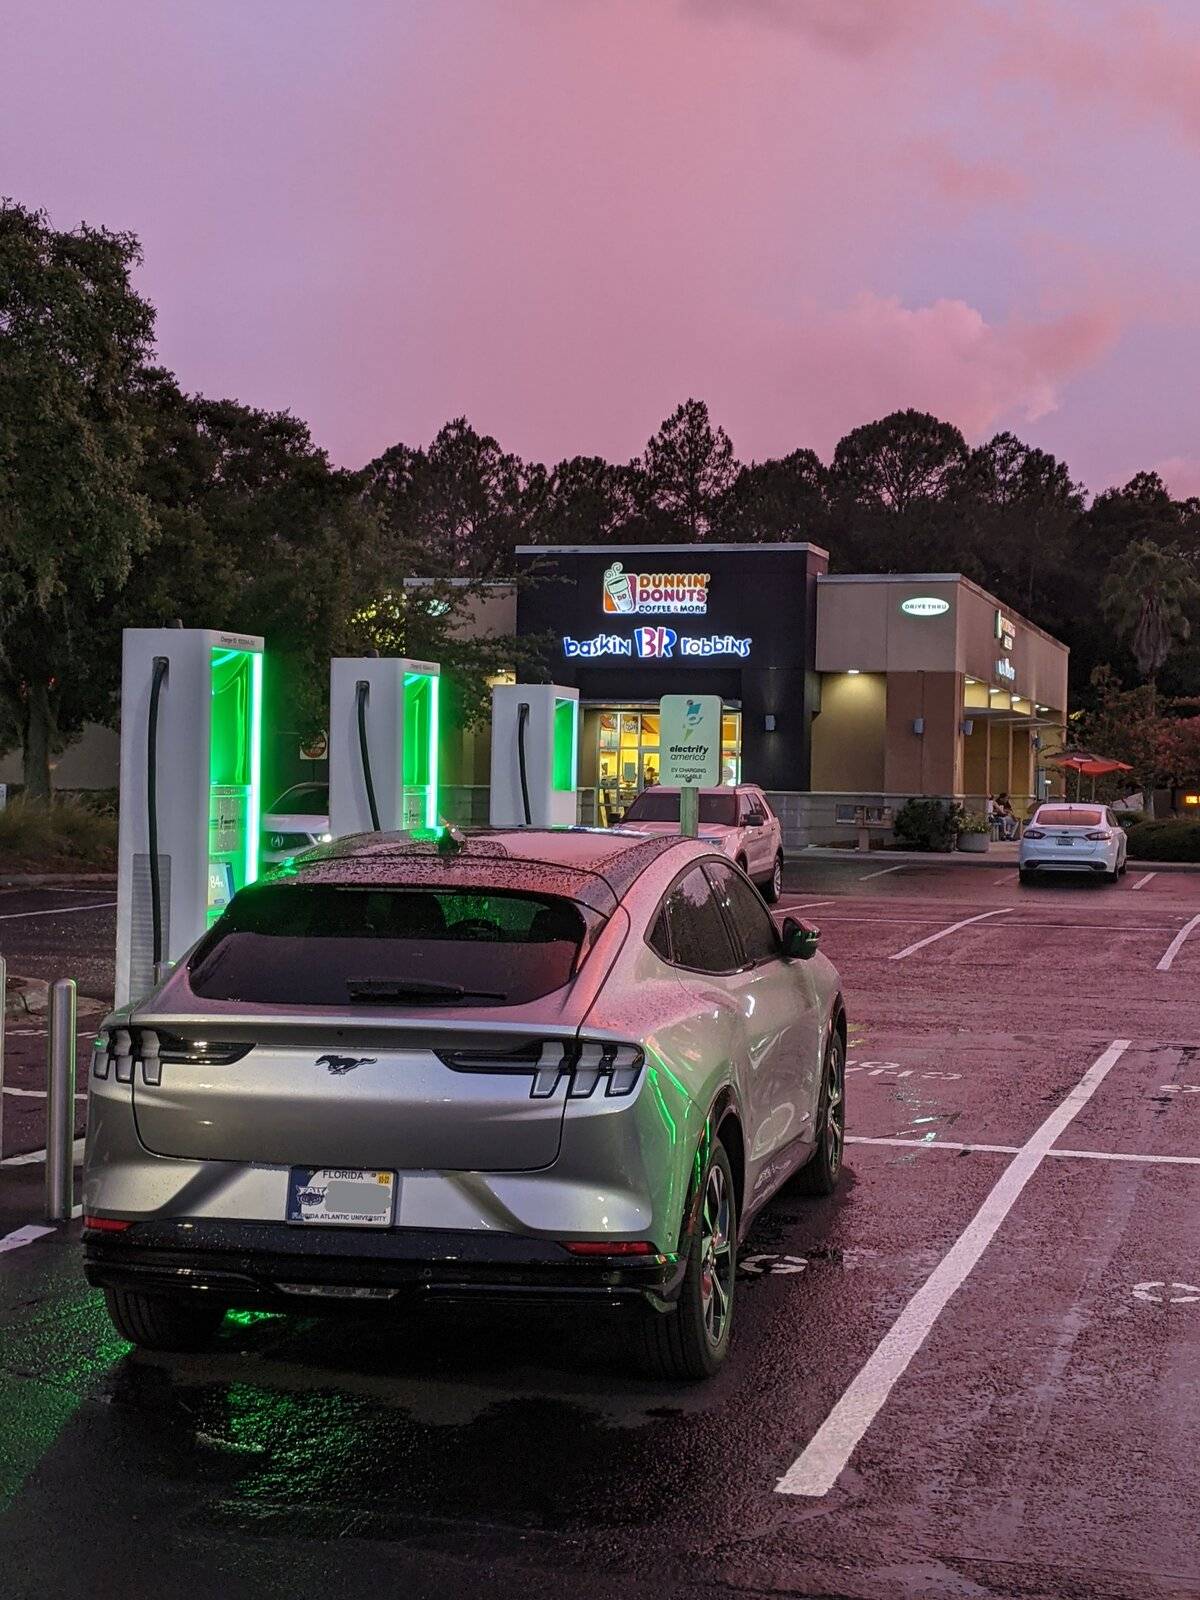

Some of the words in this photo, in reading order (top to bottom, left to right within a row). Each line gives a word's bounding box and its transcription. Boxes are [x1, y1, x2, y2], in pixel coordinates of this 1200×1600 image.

[639, 573, 710, 588] DUNKIN'
[639, 589, 707, 602] DONUTS
[638, 604, 672, 613] COFFEE
[679, 604, 706, 613] MORE
[563, 634, 632, 657] baskin
[634, 627, 677, 657] BR
[681, 636, 752, 657] robbins
[669, 745, 709, 755] electrify
[322, 1170, 364, 1180] FLORIDA
